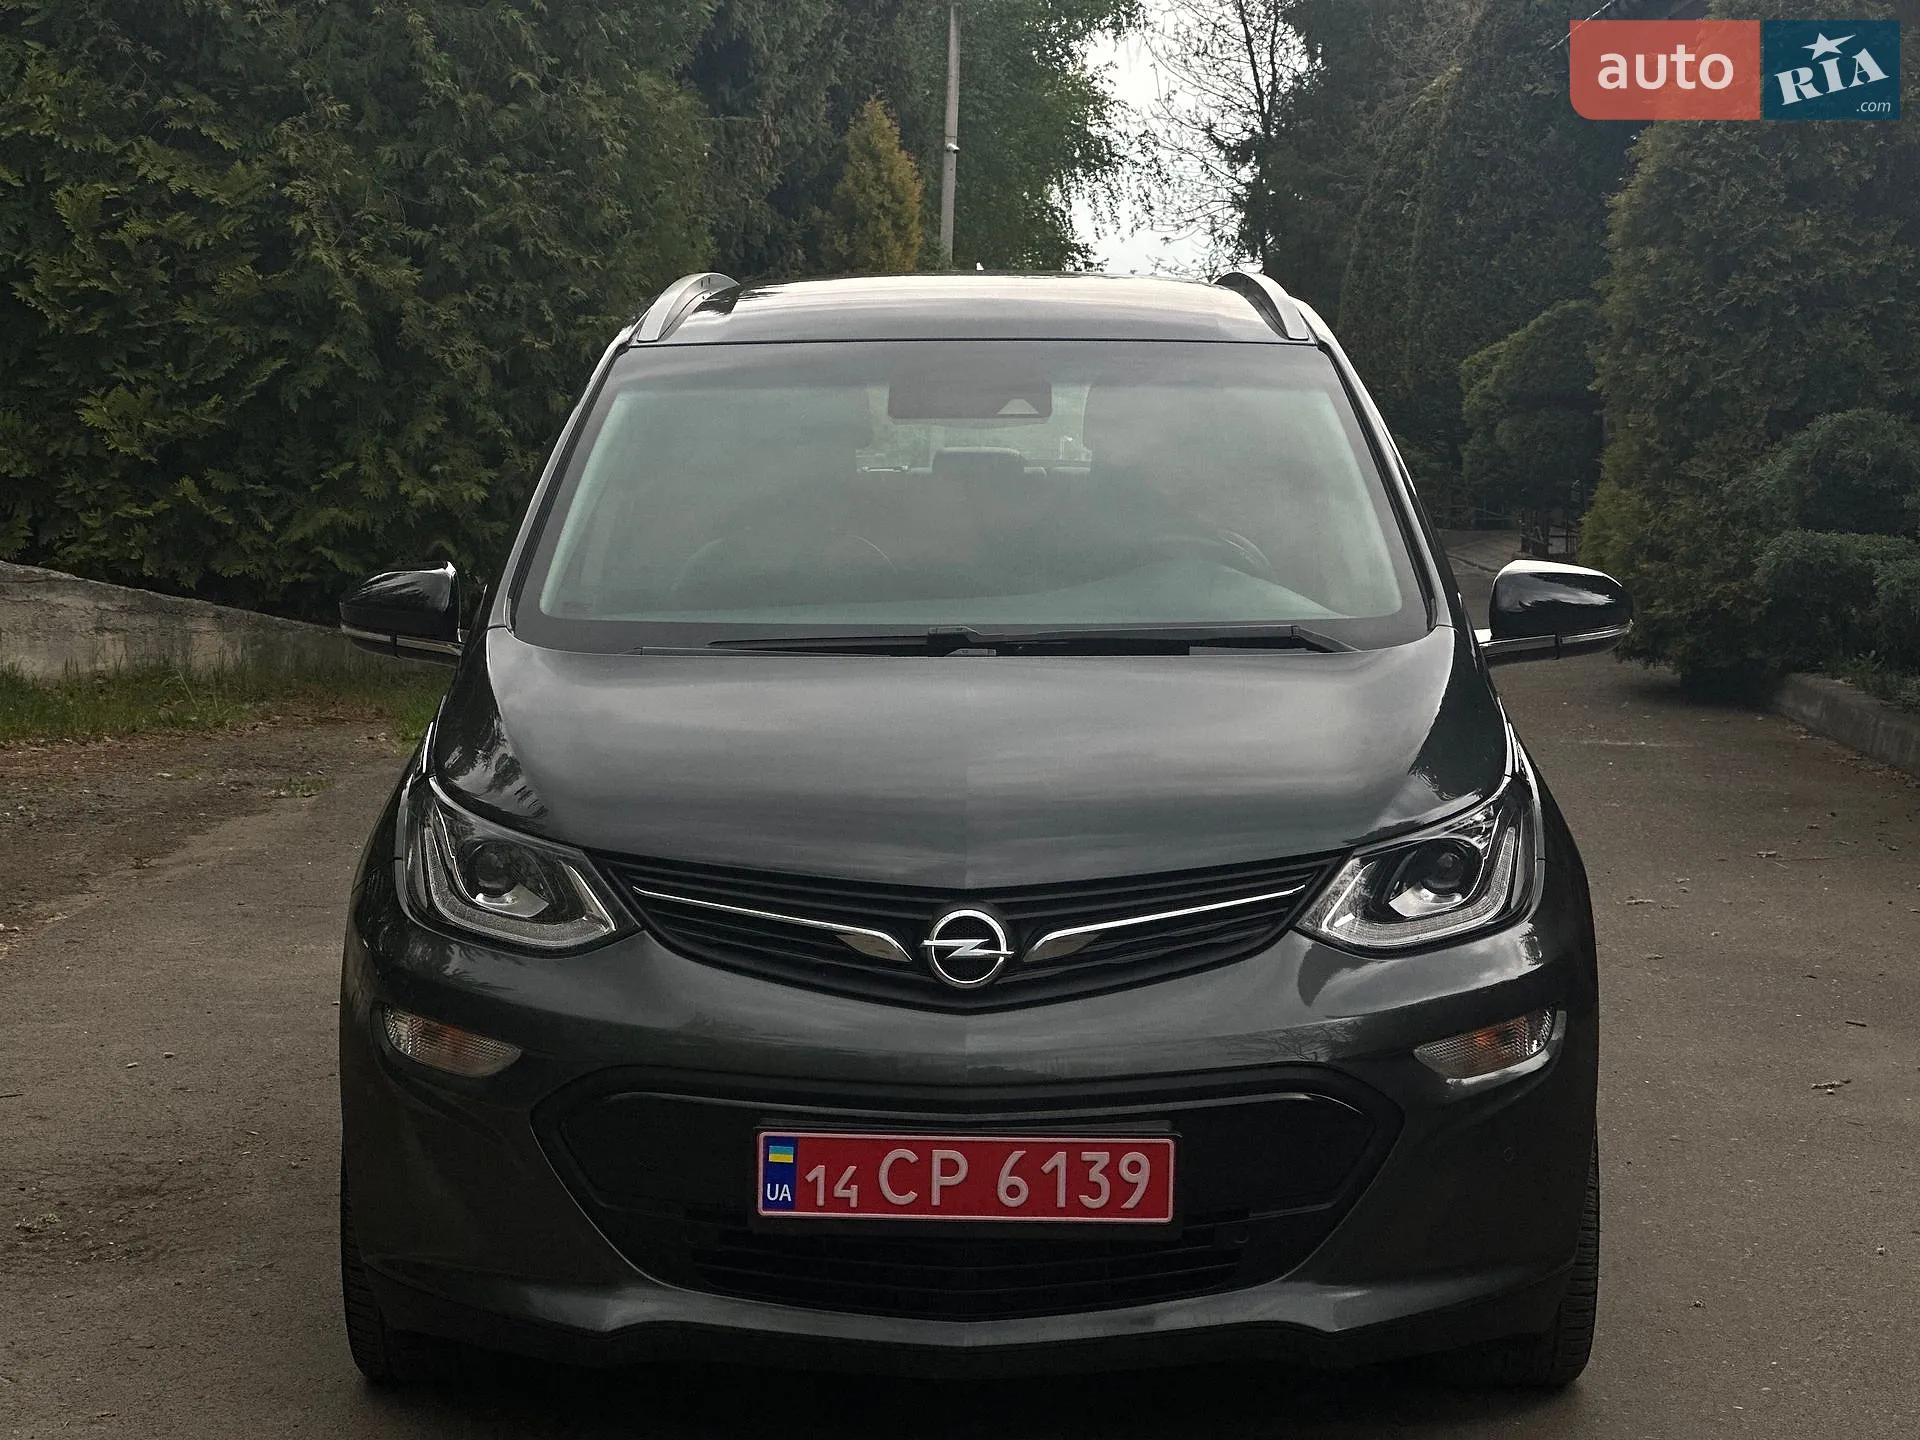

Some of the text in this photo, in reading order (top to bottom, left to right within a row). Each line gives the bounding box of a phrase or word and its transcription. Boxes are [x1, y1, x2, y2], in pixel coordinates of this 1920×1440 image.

[766, 1183, 792, 1202] UA
[805, 1148, 1151, 1209] 14 CP 6139
